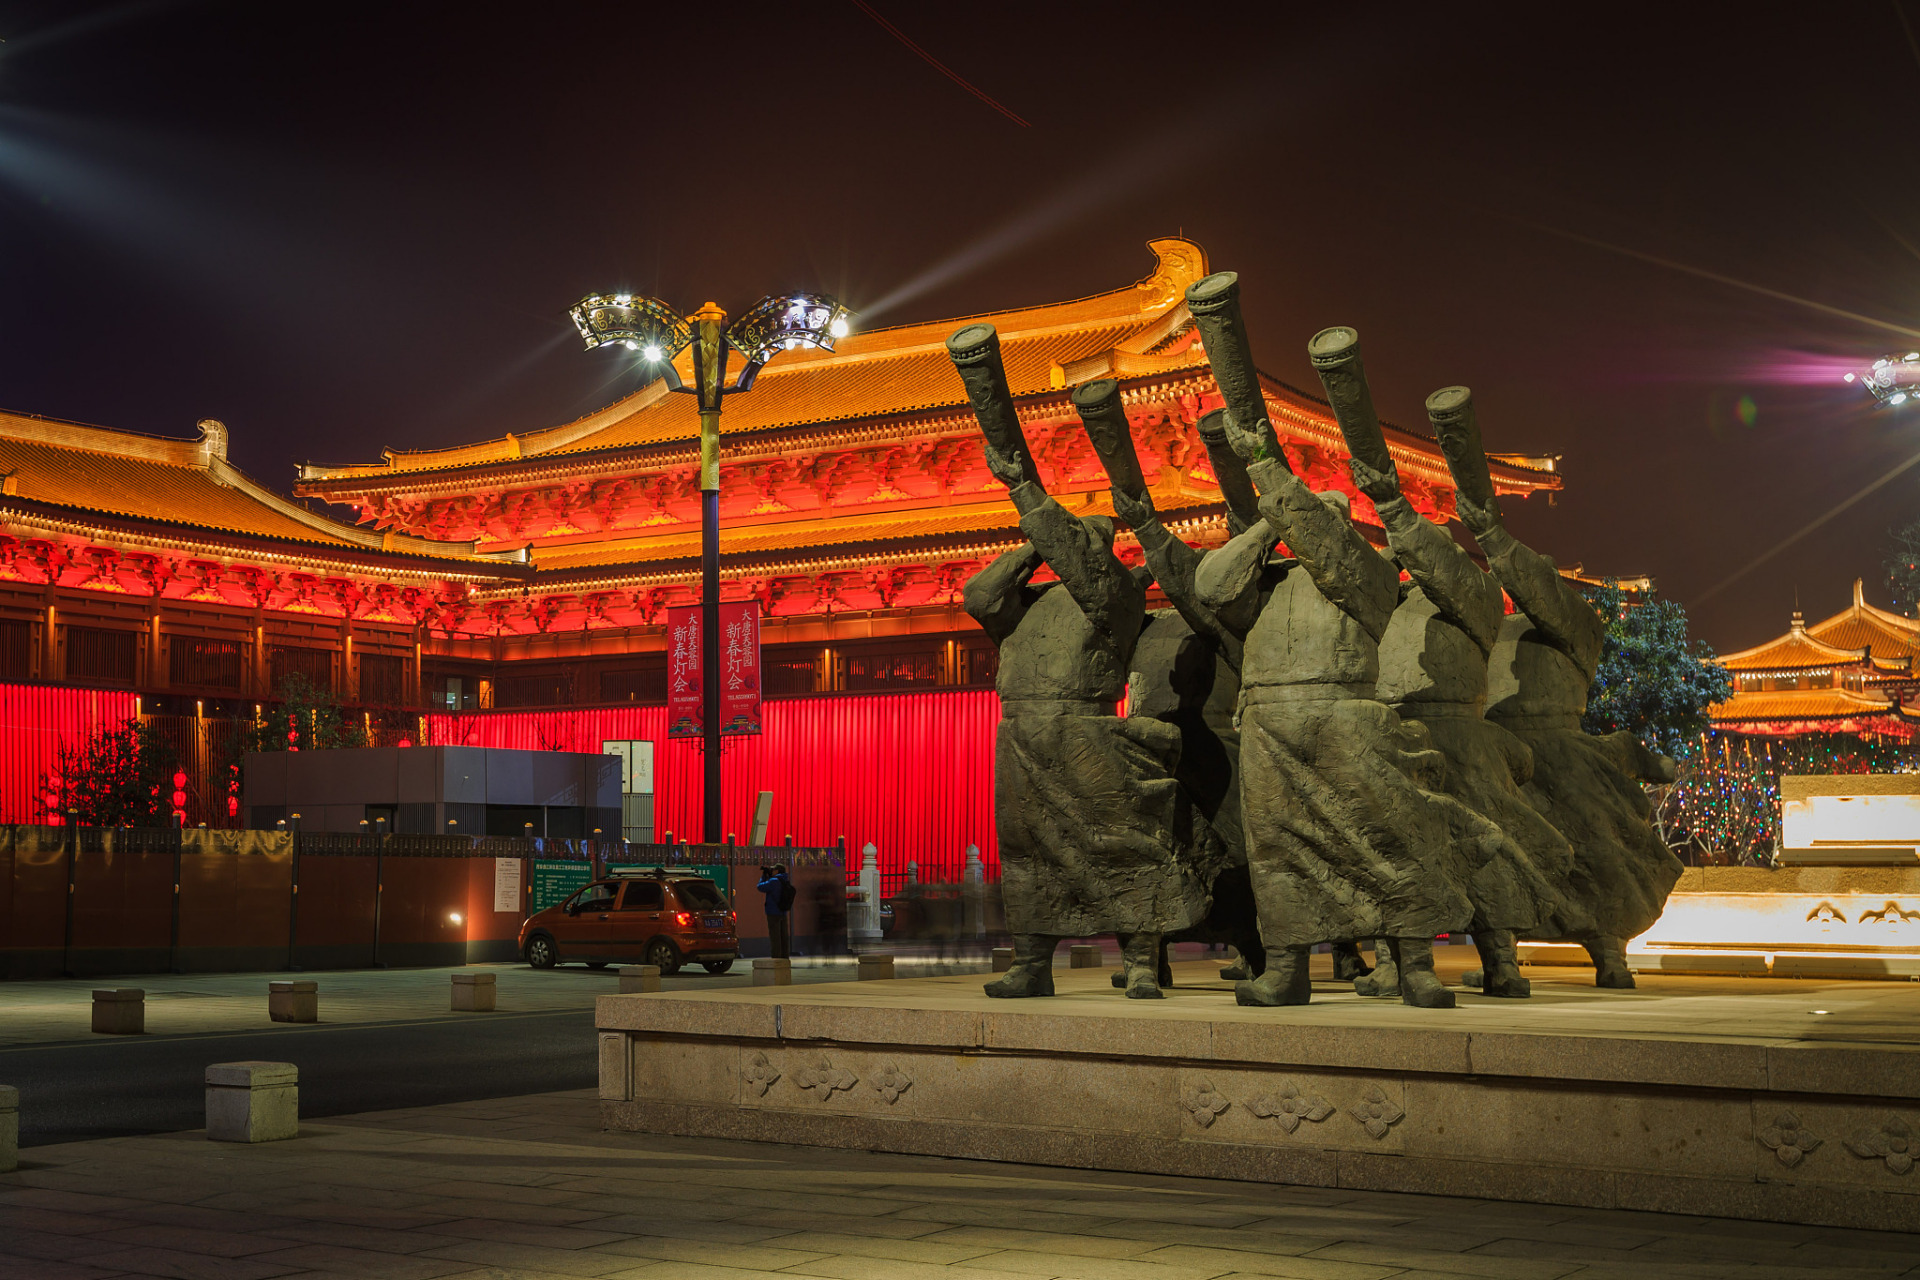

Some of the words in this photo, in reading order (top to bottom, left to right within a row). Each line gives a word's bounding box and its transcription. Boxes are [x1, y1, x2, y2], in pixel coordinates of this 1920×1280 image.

[673, 625, 688, 692] 新春灯会
[687, 612, 698, 670] 大唐芙蓉园
[726, 622, 743, 690] 新春灯会
[741, 609, 753, 667] 大唐芙蓉园
